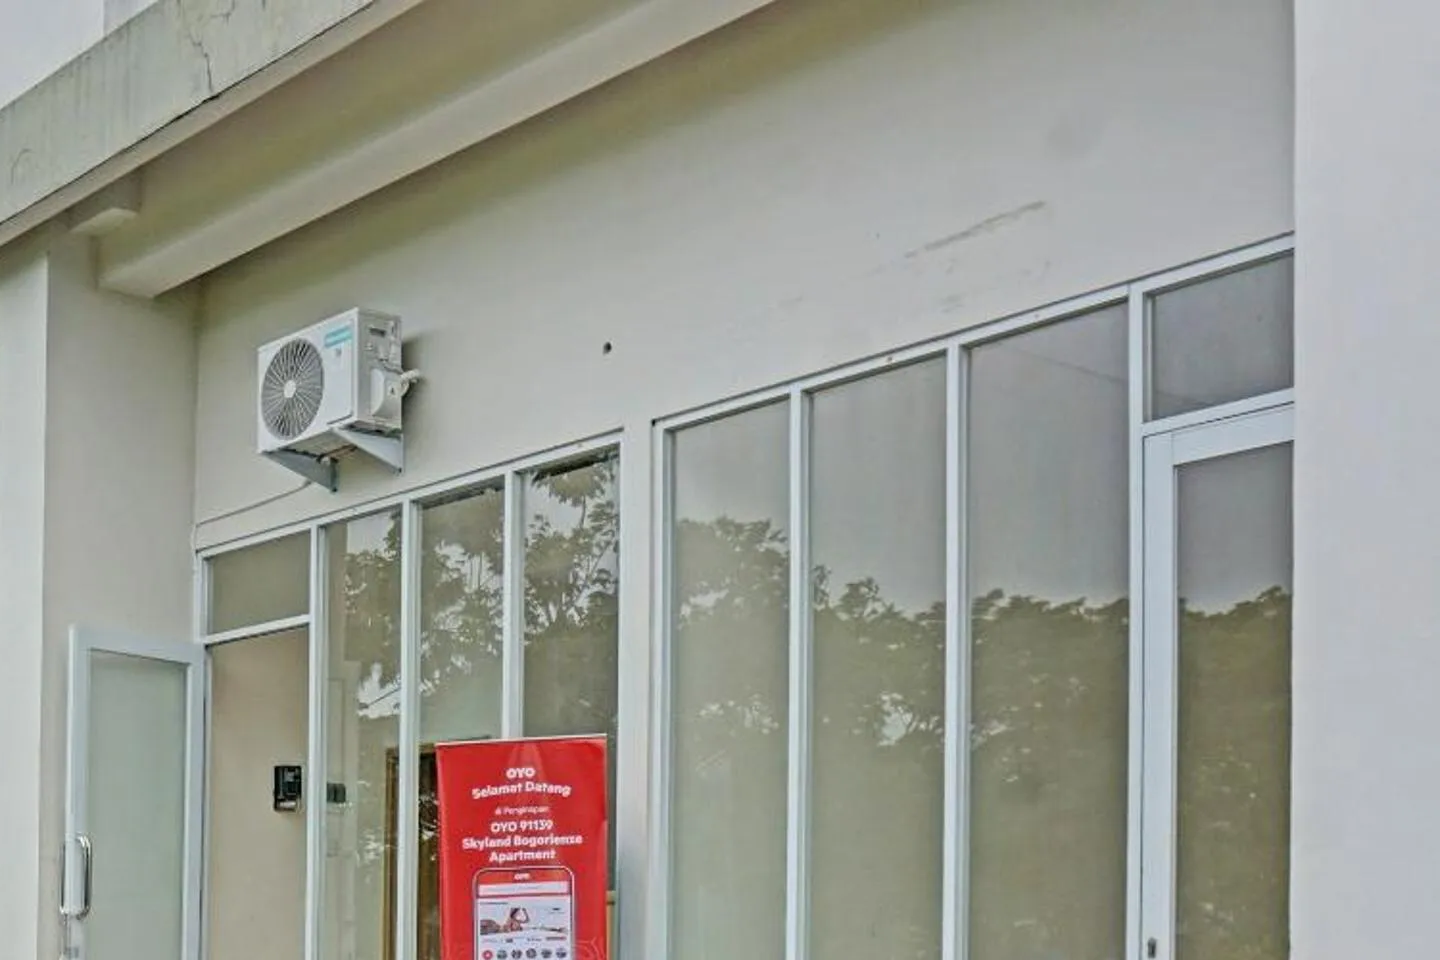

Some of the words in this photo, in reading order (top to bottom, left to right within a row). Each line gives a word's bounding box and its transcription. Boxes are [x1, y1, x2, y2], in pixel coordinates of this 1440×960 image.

[506, 767, 536, 779] OYO
[471, 783, 522, 799] Selamat
[525, 781, 572, 798] Datang
[490, 821, 517, 832] OYO
[519, 819, 554, 831] 91139
[462, 836, 511, 851] Skyland
[489, 849, 556, 864] Apartment
